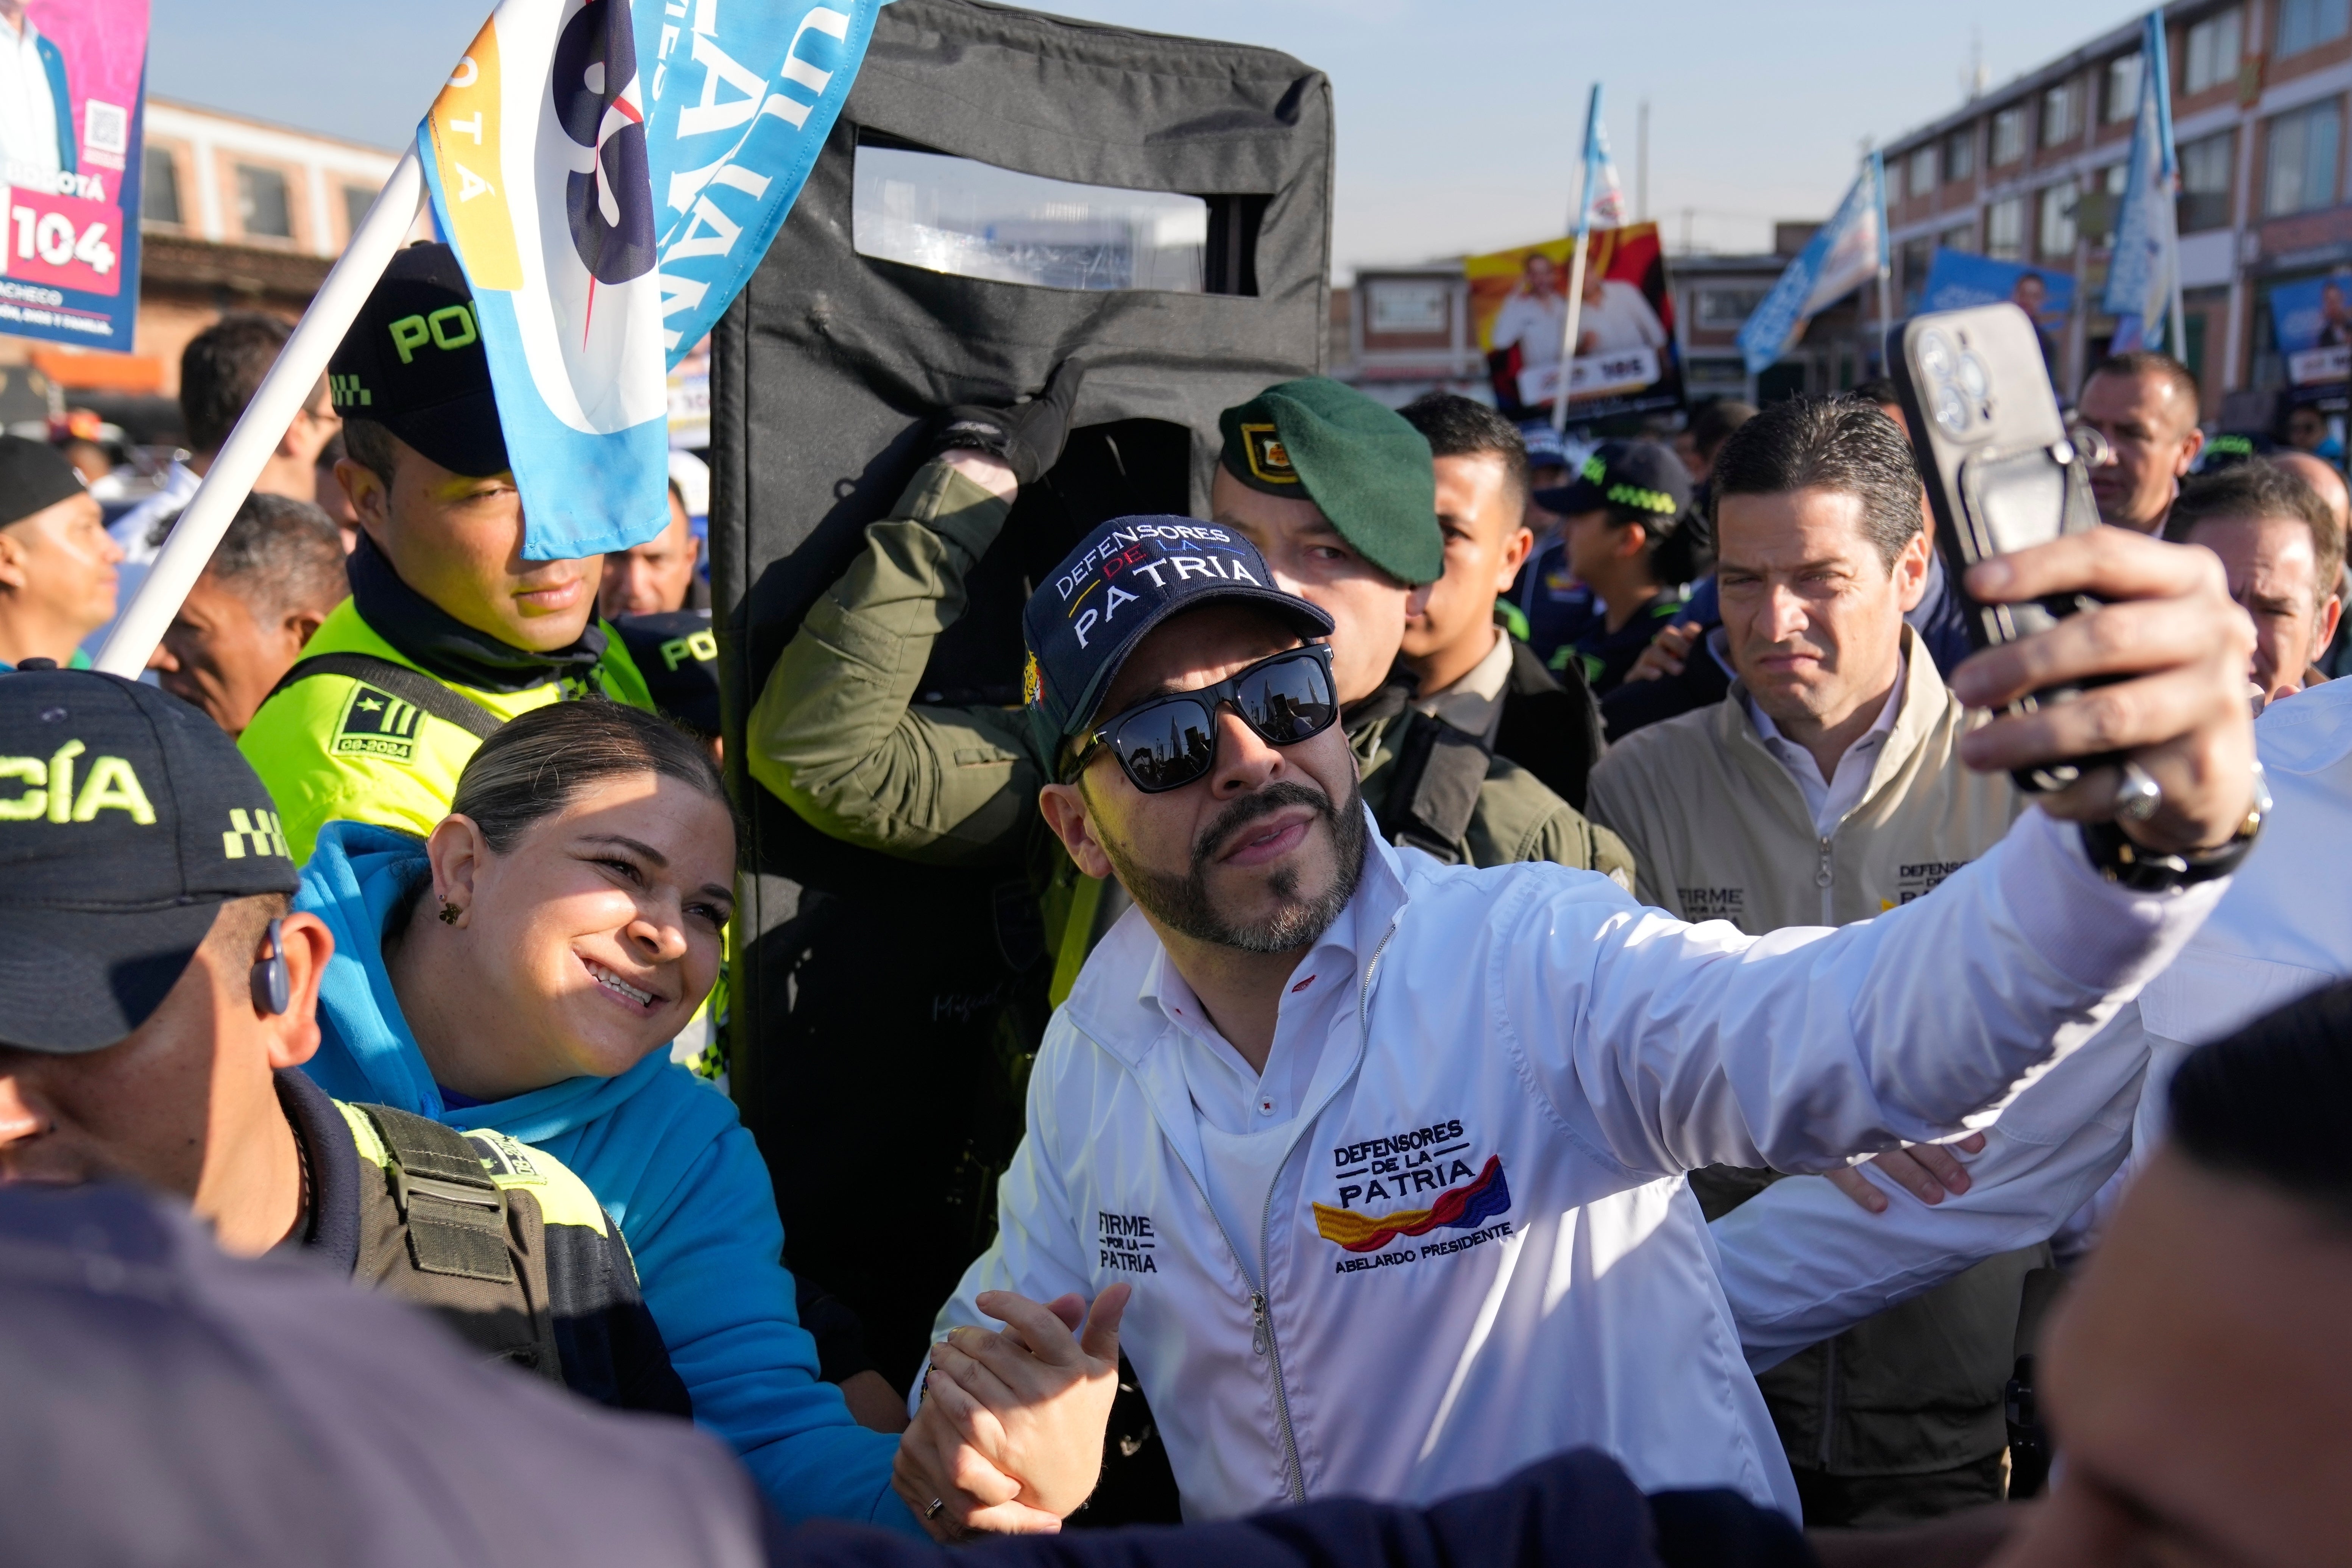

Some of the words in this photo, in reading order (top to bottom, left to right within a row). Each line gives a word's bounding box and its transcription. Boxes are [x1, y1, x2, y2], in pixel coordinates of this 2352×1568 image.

[11, 205, 115, 276] 104
[388, 301, 482, 364] PO
[1055, 524, 1230, 601] DEFENSORES
[1103, 543, 1147, 580] DE
[1156, 540, 1202, 551] LA
[1074, 556, 1262, 649] PATRIA
[660, 627, 718, 672] PO
[0, 738, 157, 825] CÍA
[1900, 861, 1968, 878] DEFENS
[1677, 888, 1743, 904] FIRME
[1334, 1119, 1463, 1167] DEFENSORES
[1371, 1158, 1399, 1175] DE
[1405, 1151, 1432, 1168] LA
[1339, 1159, 1476, 1209] PATRIA
[1099, 1211, 1154, 1238] FIRME
[1106, 1237, 1125, 1250] POR
[1127, 1239, 1139, 1251] LA
[1336, 1250, 1416, 1273] ABELARDO
[1421, 1222, 1513, 1259] PRESIDENTE
[1100, 1249, 1157, 1273] PATRIA
